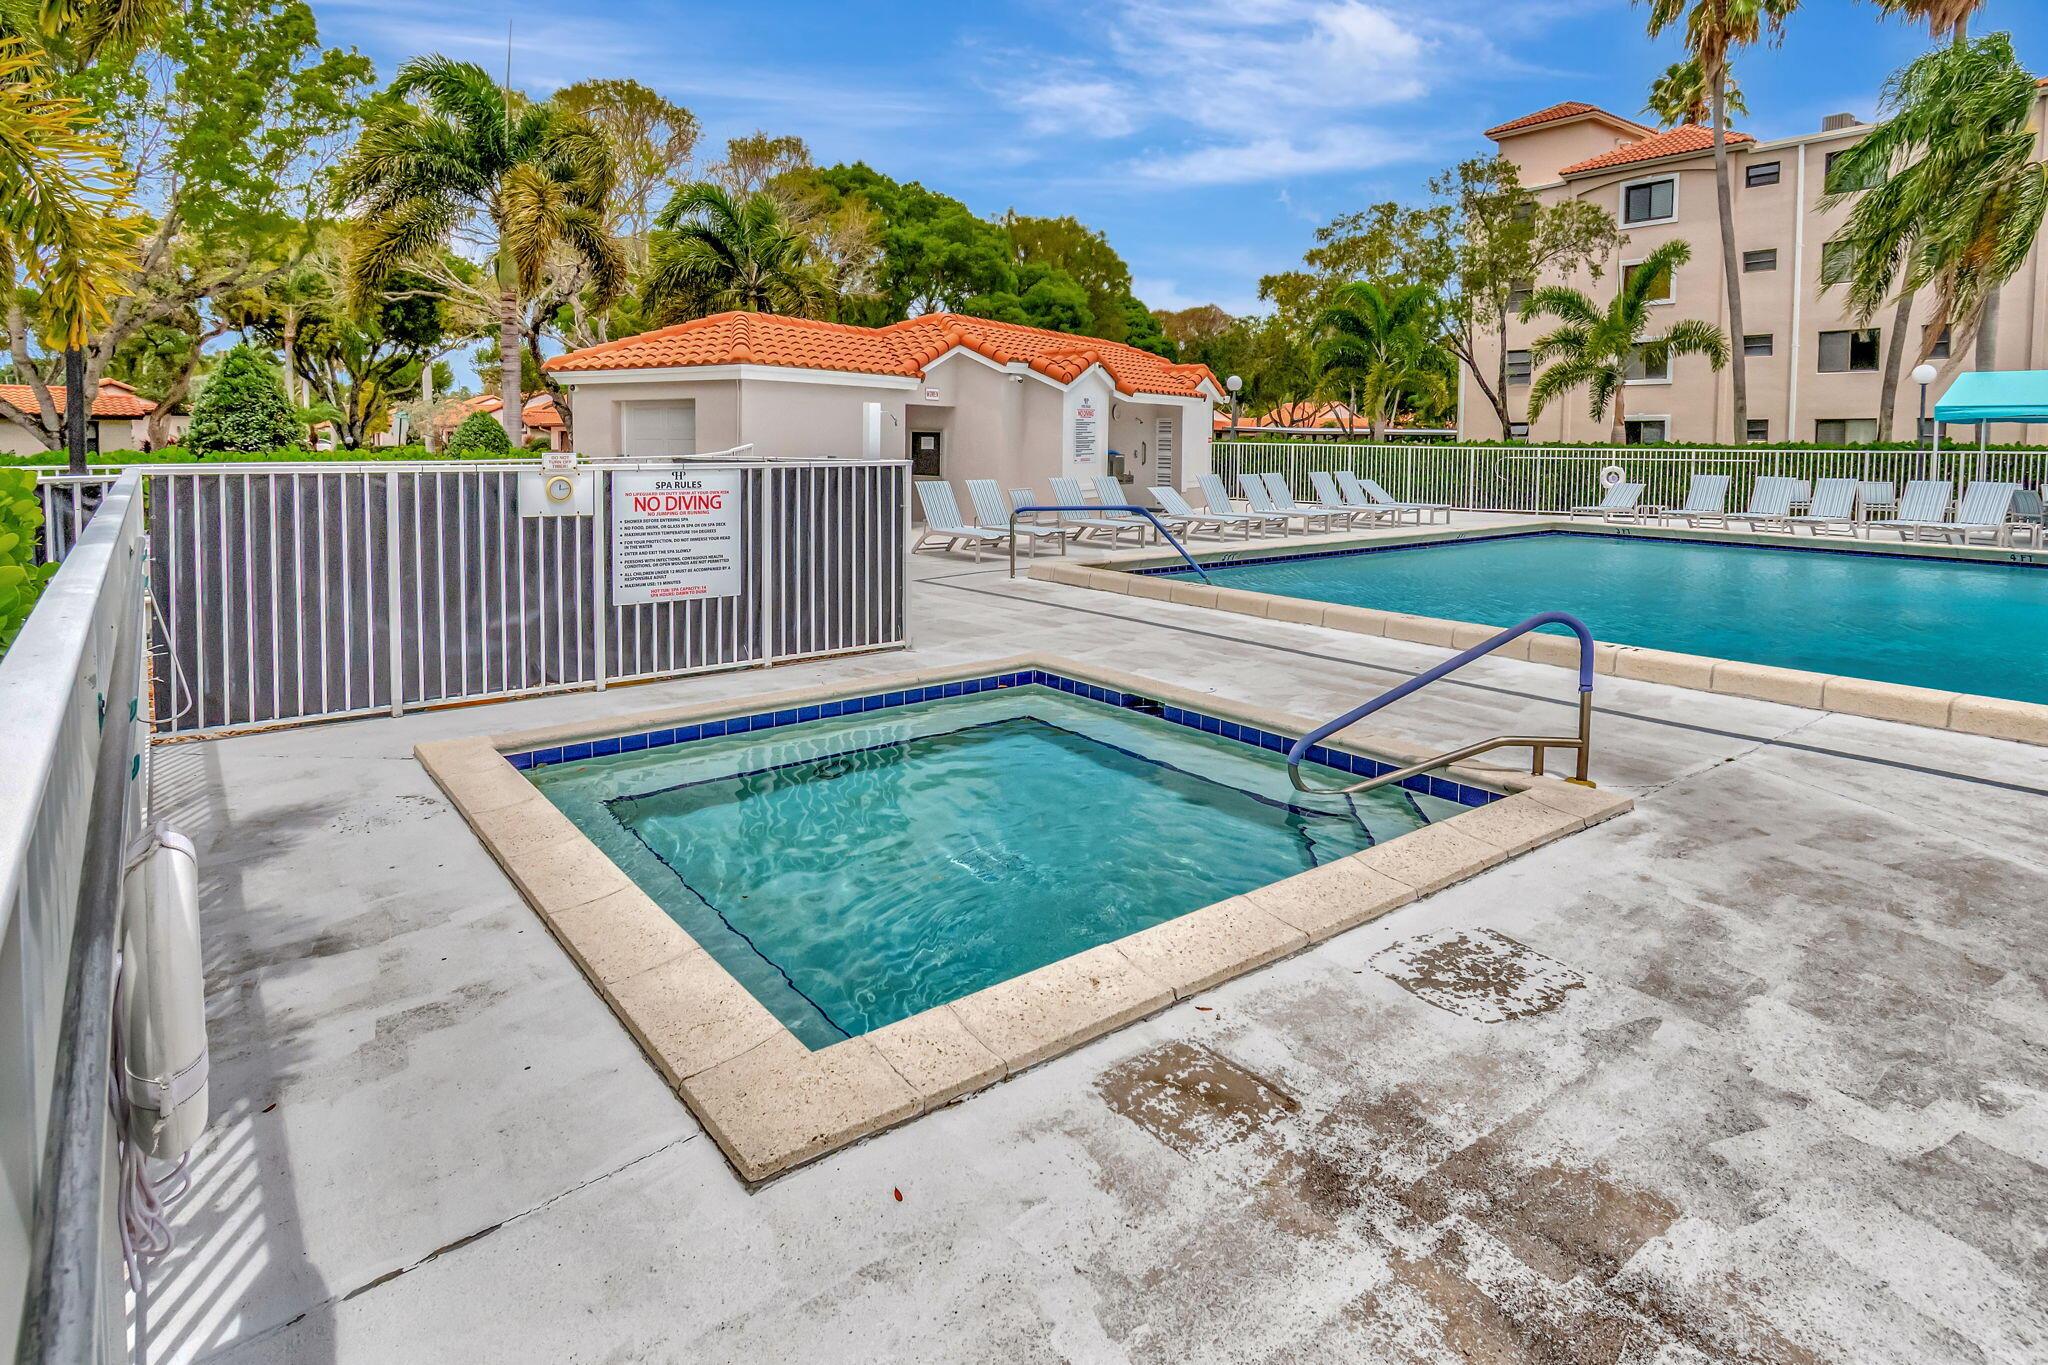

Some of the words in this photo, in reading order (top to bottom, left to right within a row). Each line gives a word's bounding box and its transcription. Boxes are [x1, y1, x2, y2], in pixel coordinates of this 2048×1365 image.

[655, 481, 672, 489] SPA
[674, 480, 702, 488] RULES
[634, 496, 660, 512] NO
[666, 495, 722, 511] DIVING
